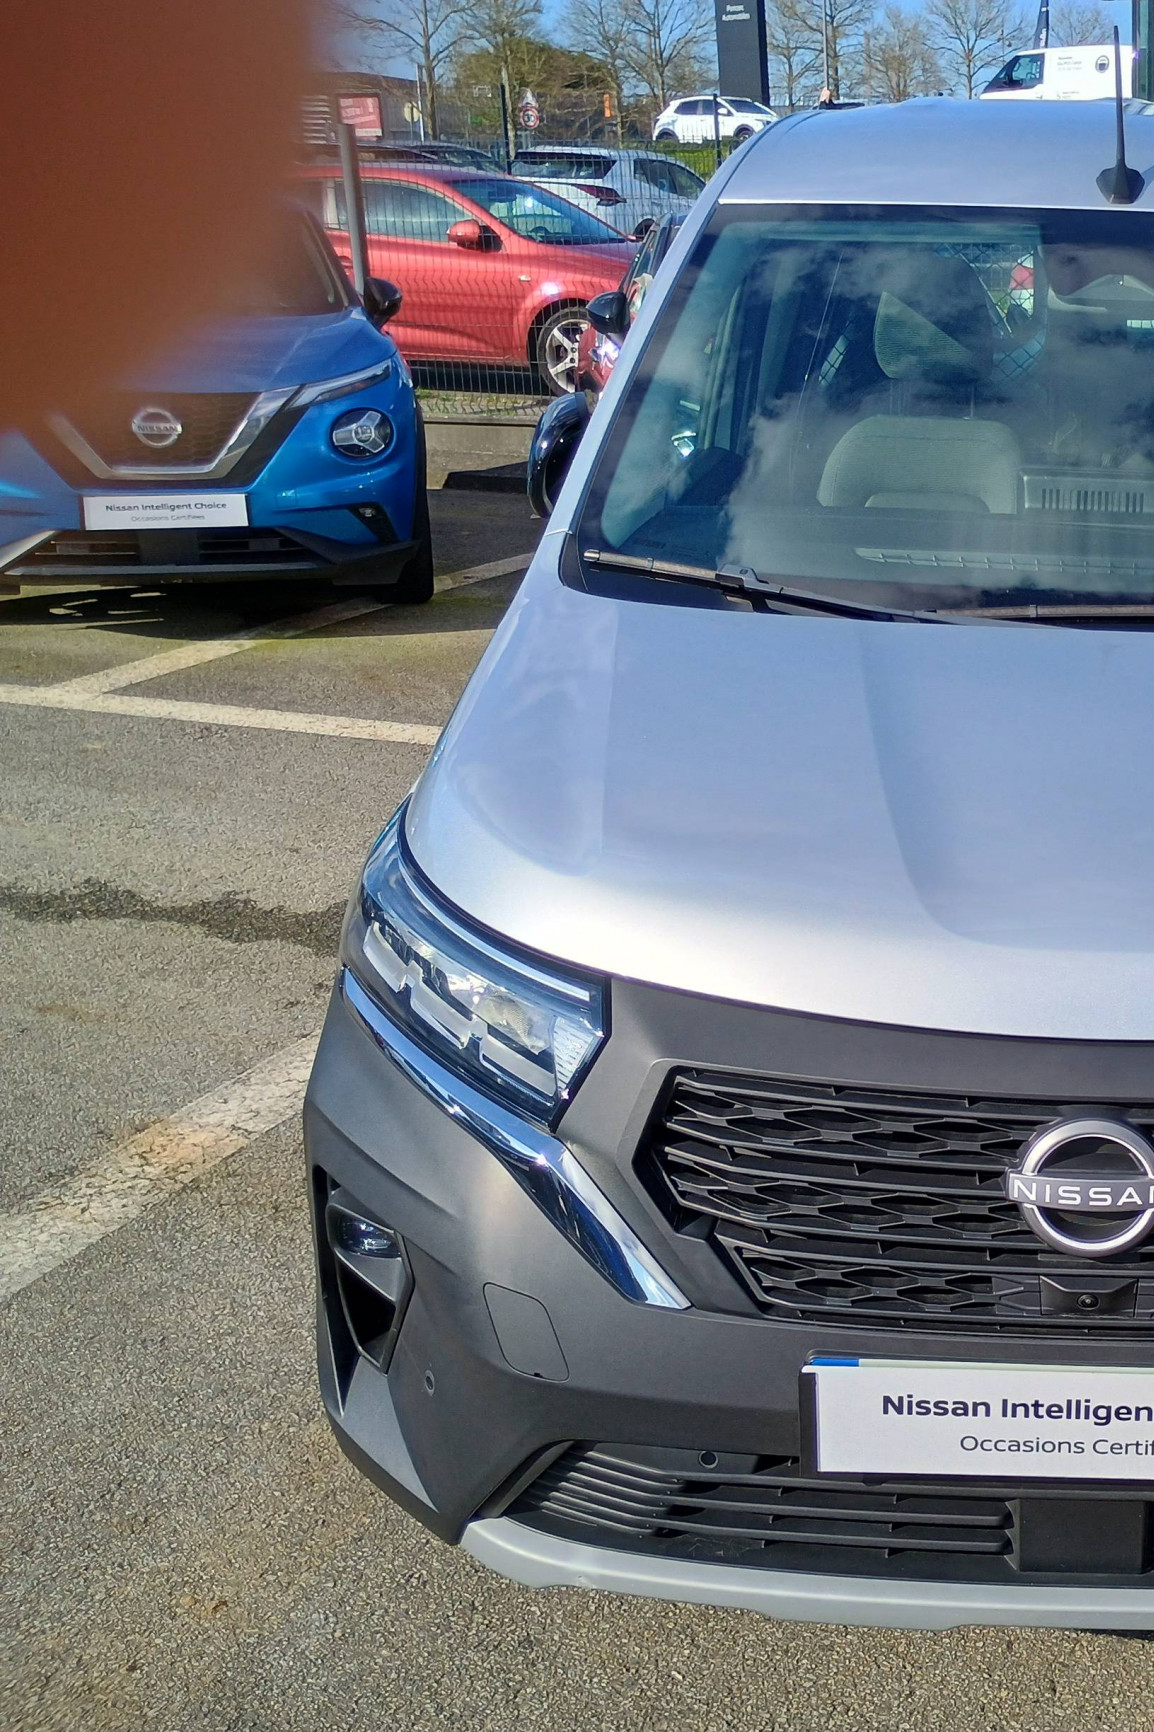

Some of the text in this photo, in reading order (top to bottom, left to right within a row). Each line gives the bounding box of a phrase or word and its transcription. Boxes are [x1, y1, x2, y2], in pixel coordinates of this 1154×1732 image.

[524, 113, 535, 123] 30
[105, 502, 227, 512] Nissan Intelligent Choice
[882, 1394, 991, 1418] Nissan
[960, 1435, 1086, 1454] Occasions
